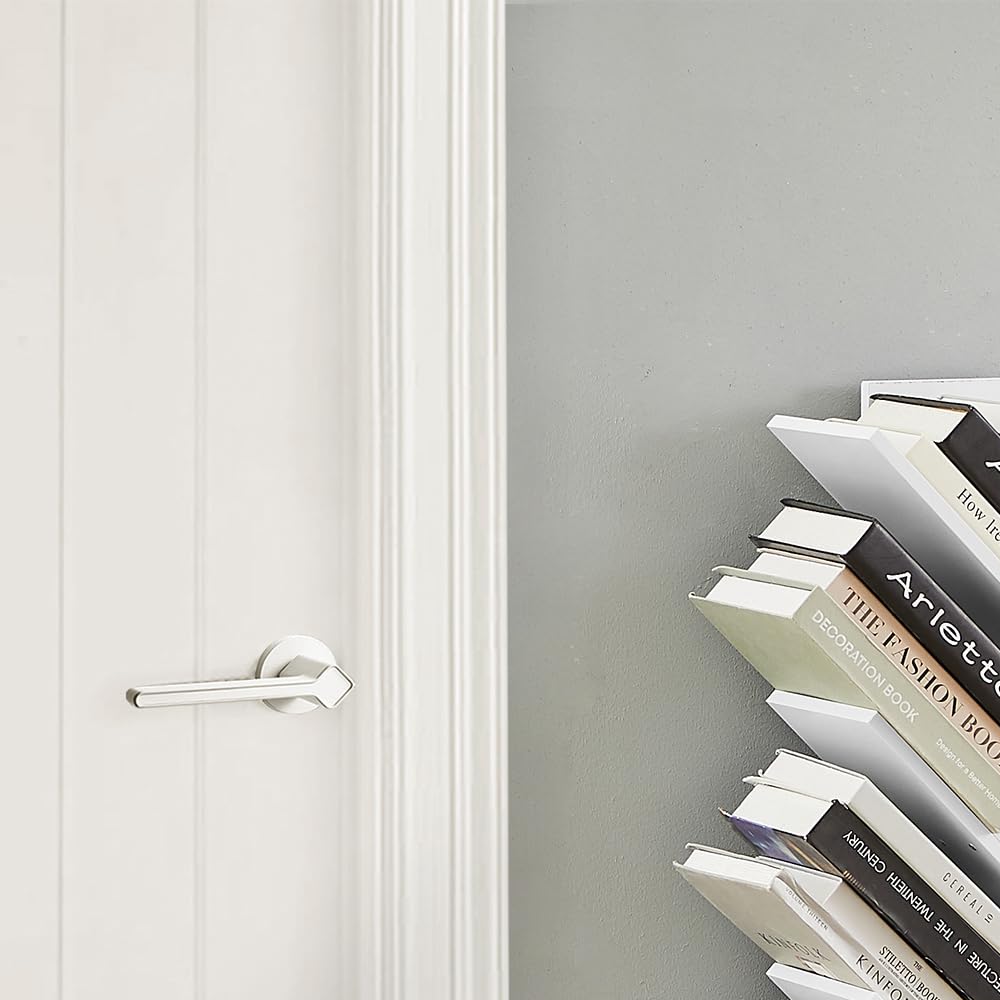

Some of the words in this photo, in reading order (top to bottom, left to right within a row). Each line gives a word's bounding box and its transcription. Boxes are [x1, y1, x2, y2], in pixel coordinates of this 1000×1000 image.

[956, 488, 986, 521] How
[811, 609, 886, 690] DECORATION
[882, 682, 920, 723] BOOK
[843, 586, 887, 637] THE
[881, 631, 961, 718] FASHON
[935, 737, 957, 763] Design
[954, 756, 967, 771] for
[967, 770, 988, 791] Better
[842, 829, 887, 874] CENTURY
[885, 871, 935, 923] TWENTIETH
[942, 872, 983, 915] CEREAL
[932, 917, 955, 942] THE
[952, 937, 969, 956] IN
[878, 945, 917, 985] STILETTO
